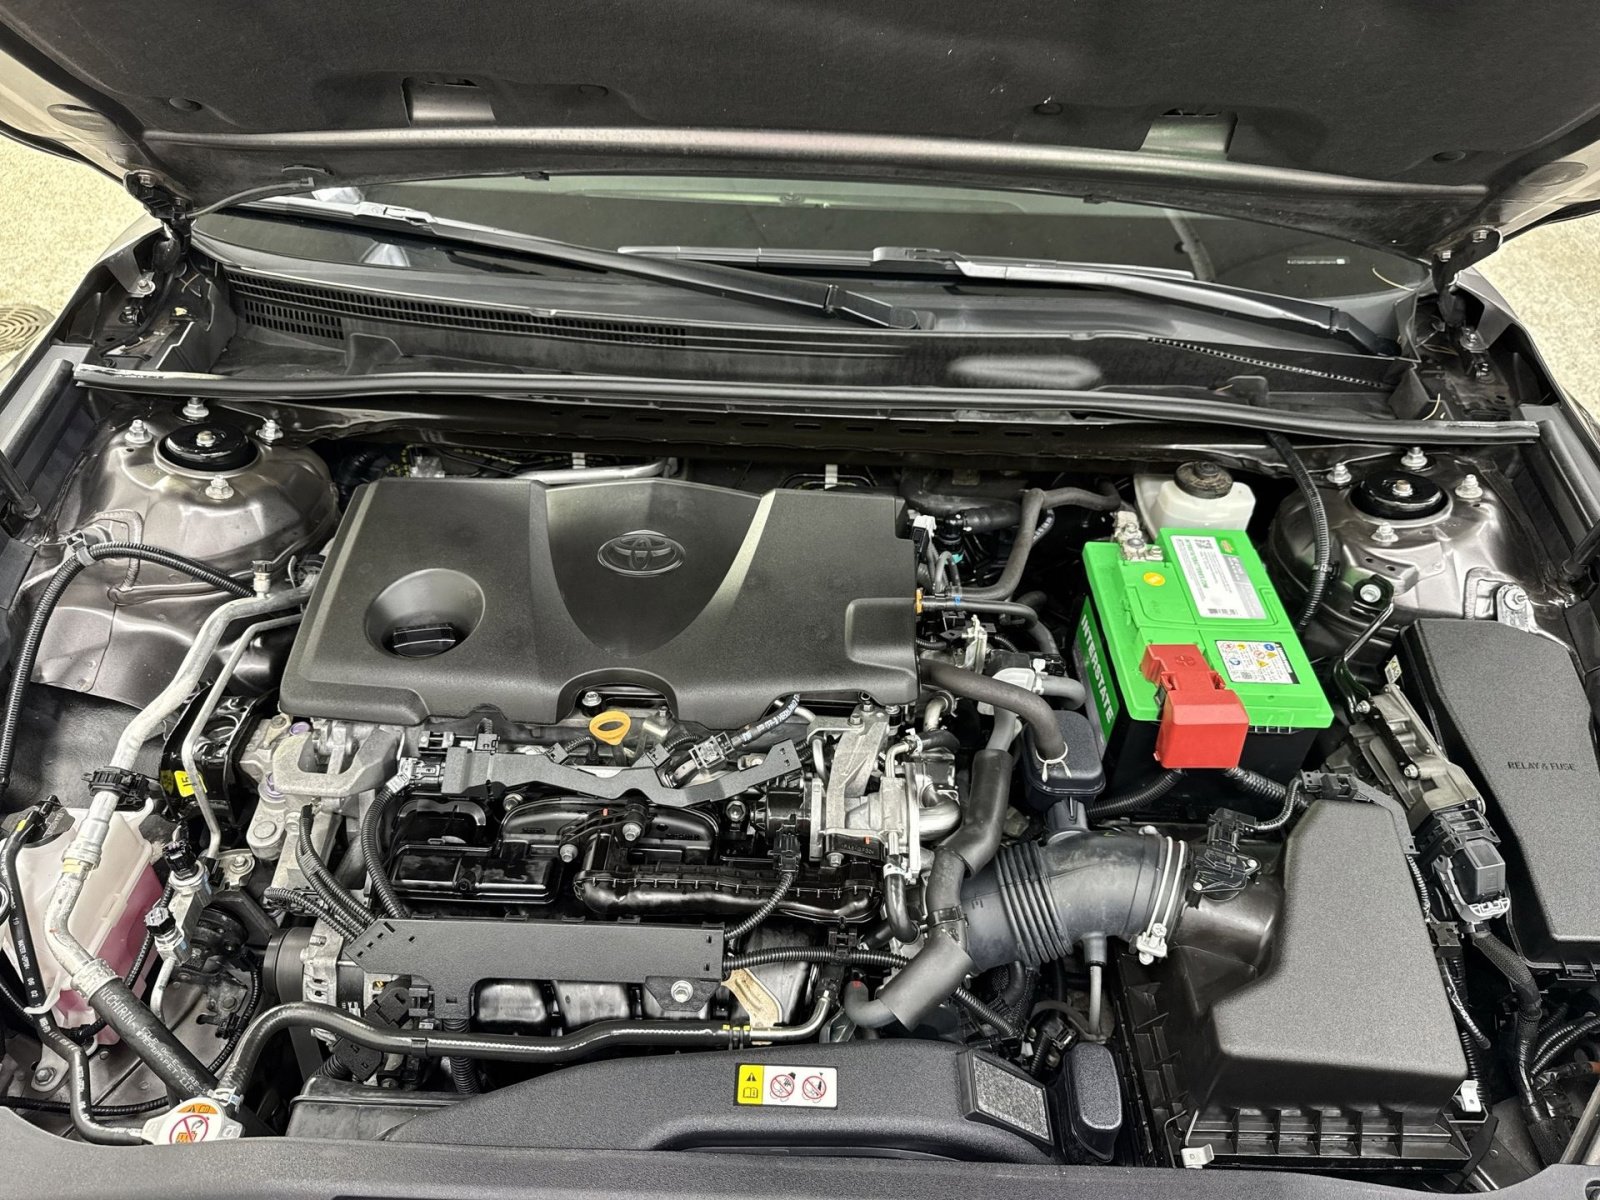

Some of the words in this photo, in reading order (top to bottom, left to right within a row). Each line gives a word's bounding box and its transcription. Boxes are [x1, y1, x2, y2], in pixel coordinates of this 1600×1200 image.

[1081, 614, 1114, 724] INTERSTATE
[1507, 761, 1539, 770] RELAY
[1550, 762, 1576, 771] FUSE
[98, 987, 136, 1025] NICHIRIN
